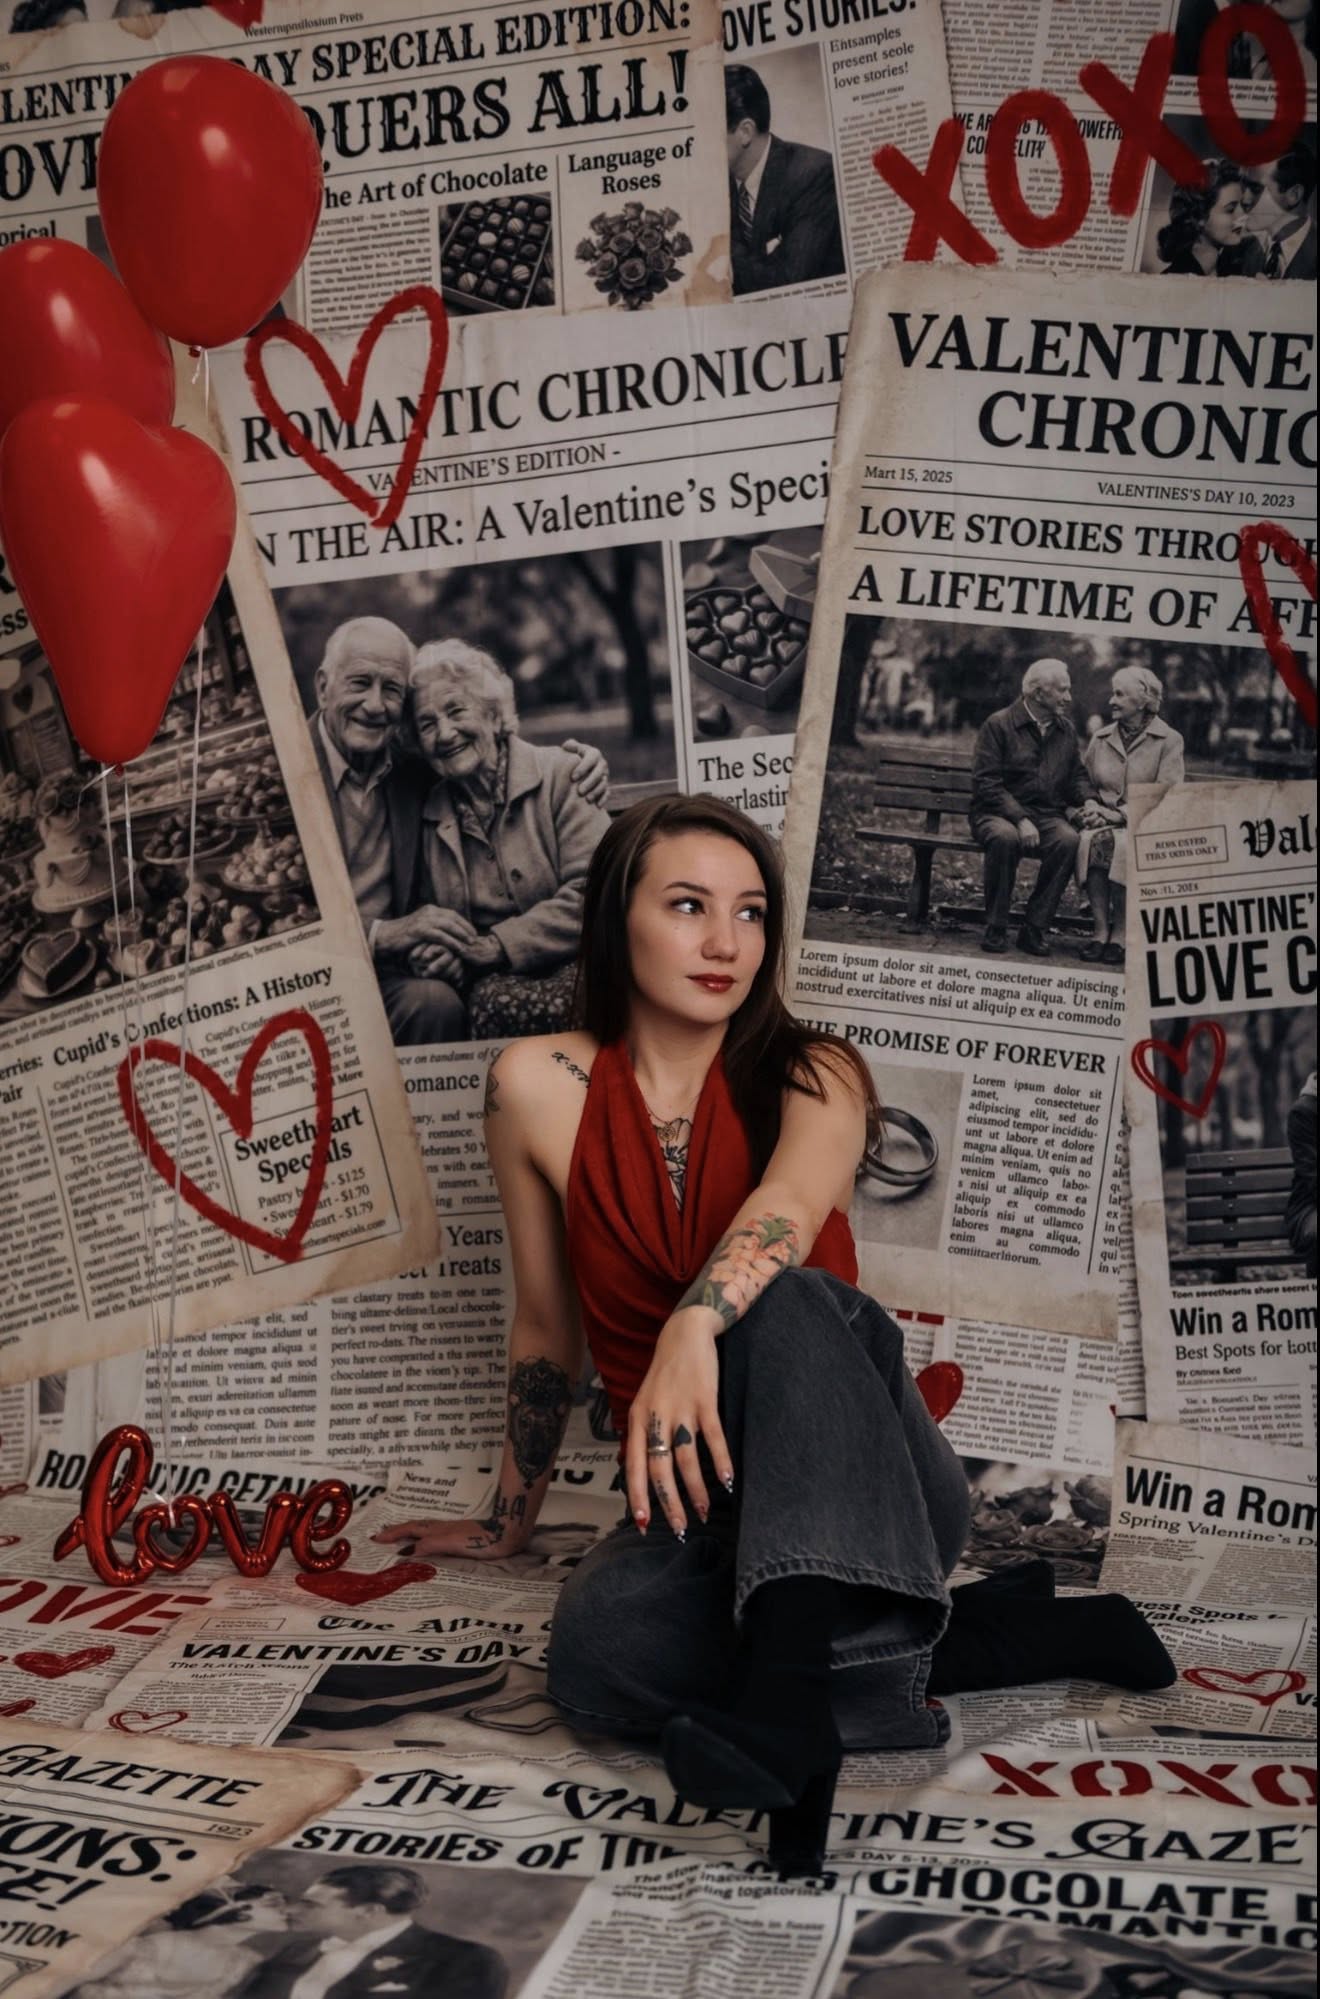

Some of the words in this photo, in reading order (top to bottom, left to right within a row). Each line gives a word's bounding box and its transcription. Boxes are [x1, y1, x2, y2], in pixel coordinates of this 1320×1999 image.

[226, 49, 302, 87] AY
[312, 23, 485, 82] SPECIAL
[496, 0, 691, 57] EDITION:
[832, 51, 878, 74] present
[527, 49, 690, 134] ALL!
[834, 76, 860, 89] love
[863, 61, 909, 83] stories!
[567, 146, 668, 174] Language
[671, 138, 695, 159] of
[872, 3, 1307, 266] XOXO
[324, 187, 351, 209] he
[358, 181, 397, 206] Art
[401, 174, 425, 198] of
[430, 161, 549, 194] Chocolate
[601, 173, 661, 195] Roses
[888, 311, 1315, 392] VALENTINE
[515, 443, 607, 474] EDITION
[900, 468, 919, 484] 15,
[921, 469, 953, 484] 2025
[252, 532, 277, 566] N
[289, 521, 371, 564] THE
[381, 511, 464, 553] AIR:
[475, 504, 506, 542] A
[513, 478, 717, 537] Valentine's
[730, 460, 830, 517] Speci
[1204, 489, 1237, 504] DAY
[1238, 491, 1258, 508] 10,
[1261, 492, 1296, 508] 2023
[858, 505, 955, 542] LOVE
[964, 513, 1123, 554] STORIES
[848, 565, 882, 602] A
[896, 567, 1134, 623] LIFETIME
[1148, 588, 1218, 628] OF
[697, 757, 745, 782] The
[752, 752, 793, 777] Sec
[1140, 891, 1315, 943] VALENTINE'
[797, 963, 858, 981] incididunt
[862, 971, 874, 983] ut
[879, 972, 917, 988] labore
[921, 978, 932, 989] et
[937, 980, 976, 995] dolore
[980, 986, 1021, 1000] magna
[1026, 989, 1067, 1006] aliqua.
[1072, 994, 1088, 1008] Ut
[1093, 998, 1126, 1012] enim
[800, 948, 838, 963] Lorem
[842, 953, 879, 968] ipsum
[883, 957, 916, 972] dolor
[919, 961, 934, 974] sit
[938, 965, 971, 980] amet,
[975, 969, 1054, 987] consectetuer
[1056, 977, 1119, 997] adipiscing
[1146, 935, 1274, 1009] LOVE
[53, 1030, 121, 1066] Cupid's
[245, 987, 261, 1007] A
[262, 966, 332, 999] History
[795, 980, 844, 995] nostrud
[928, 994, 952, 1008] nisi
[956, 999, 969, 1010] ut
[972, 1000, 1017, 1018] aliquip
[1020, 1006, 1036, 1018] ex
[1039, 1008, 1054, 1019] ea
[1057, 1010, 1122, 1027] commodo
[844, 1024, 951, 1055] PROMISE
[956, 1037, 989, 1059] OF
[993, 1041, 1106, 1074] FOREVER
[404, 1074, 480, 1093] omance
[970, 1088, 999, 1101] amet,
[972, 1074, 1006, 1089] Lorem
[1014, 1079, 1046, 1093] ipsum
[1053, 1083, 1081, 1098] dolor
[1089, 1087, 1103, 1100] sit
[234, 1104, 364, 1161] Sweethart
[966, 1114, 1010, 1128] eiusmod
[1012, 1120, 1050, 1135] tempor
[968, 1100, 1021, 1118] adipiscing
[1029, 1109, 1049, 1121] elit,
[1058, 1111, 1076, 1124] sed
[1085, 1114, 1099, 1126] do
[965, 1127, 983, 1138] unt
[989, 1129, 1000, 1139] ut
[1006, 1130, 1039, 1145] labore
[1044, 1137, 1056, 1148] et
[1061, 1137, 1095, 1151] dolore
[257, 1140, 352, 1184] Specals
[258, 1190, 293, 1209] Pastry
[446, 1225, 504, 1247] Years
[1169, 1305, 1223, 1337] Win
[1231, 1311, 1248, 1334] a
[1175, 1344, 1208, 1361] Best
[1212, 1343, 1256, 1361] Spots
[1260, 1340, 1283, 1356] for
[36, 1450, 211, 1497] RONTIC
[403, 1472, 431, 1487] News
[433, 1477, 457, 1488] and
[1125, 1465, 1194, 1513] Win
[1202, 1488, 1226, 1518] a
[53, 1423, 352, 1586] love
[1118, 1511, 1181, 1534] Spring
[1188, 1521, 1291, 1546] Valentine's
[317, 1615, 396, 1631] The
[1188, 1604, 1259, 1621] Spots
[181, 1643, 447, 1663] VALENTINE'S
[454, 1640, 532, 1664] DAY
[0, 1744, 265, 1809] GAZETTE
[980, 1752, 1317, 1807] XOXO
[361, 1768, 515, 1811] THE
[543, 1780, 1036, 1849] VALEINE'S
[1044, 1818, 1317, 1864] GAZE
[291, 1825, 504, 1863] STORIES
[516, 1835, 586, 1870] OF
[861, 1850, 895, 1863] DAY
[868, 1867, 1268, 1920] CHOCOLATE
